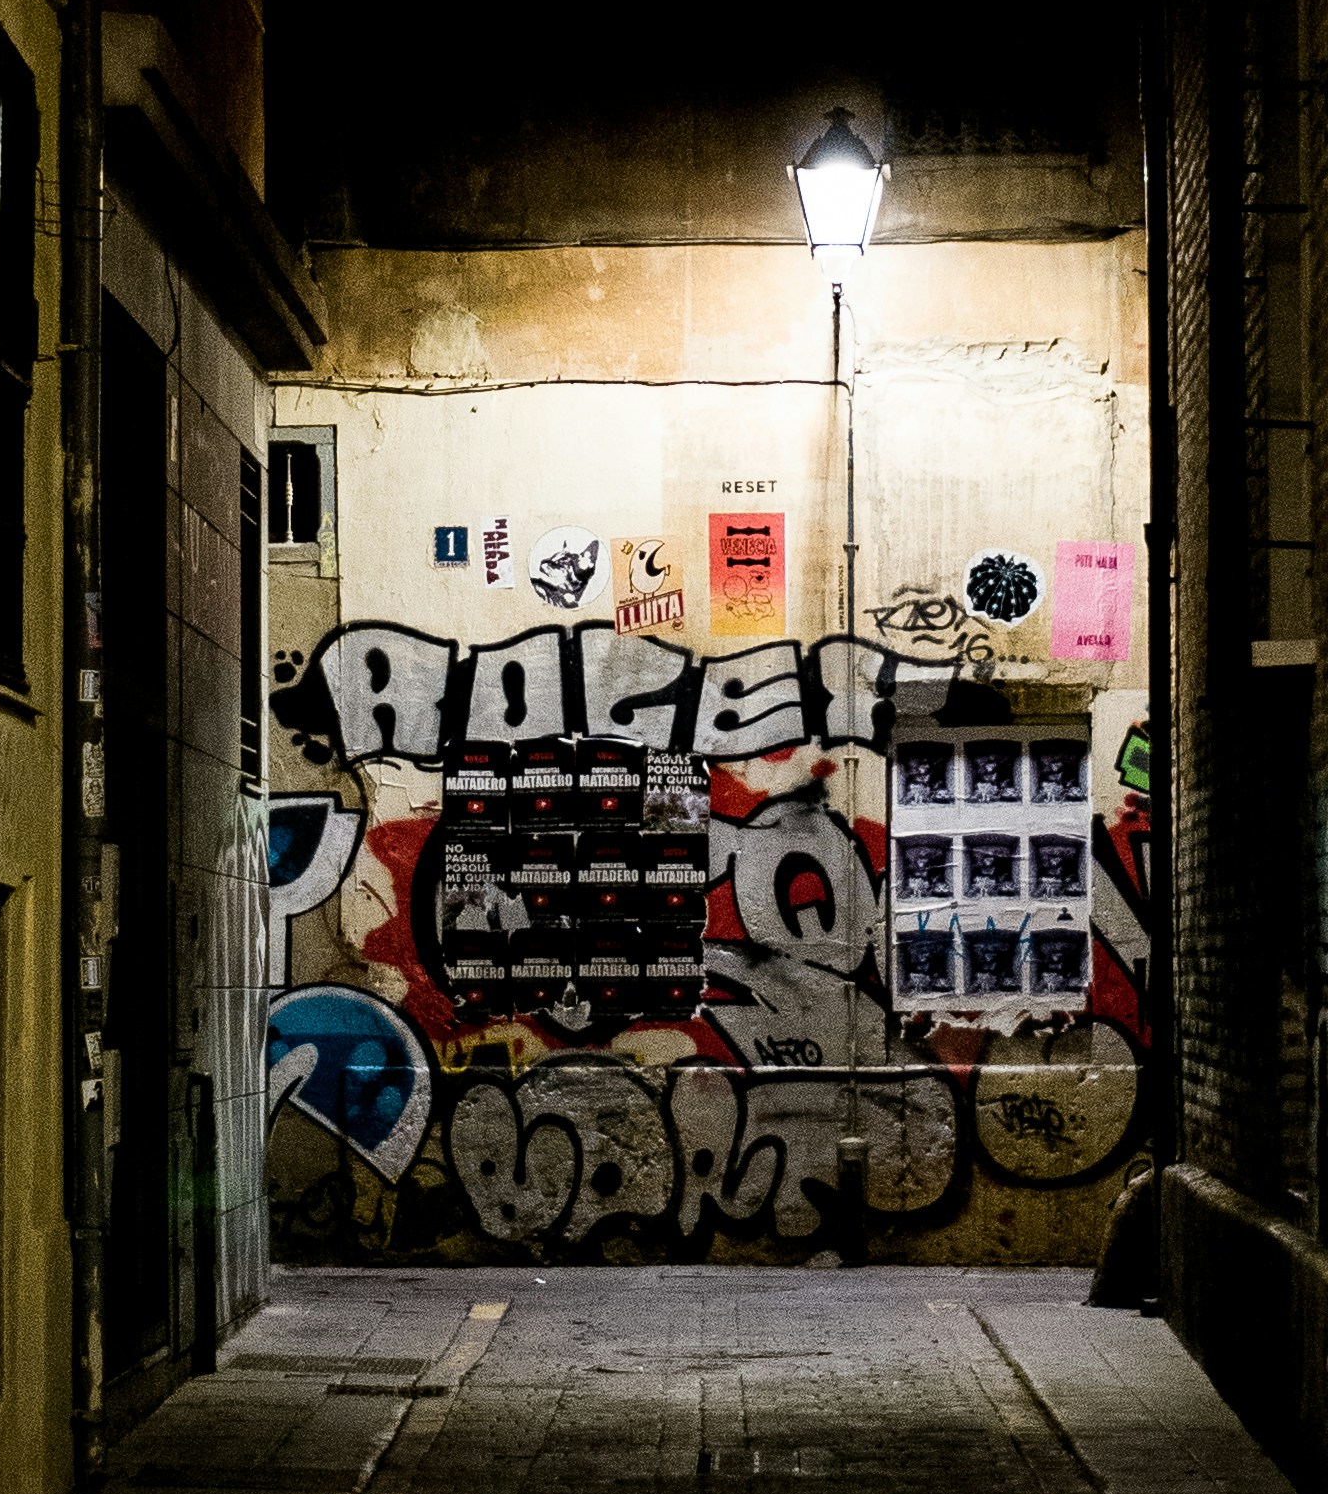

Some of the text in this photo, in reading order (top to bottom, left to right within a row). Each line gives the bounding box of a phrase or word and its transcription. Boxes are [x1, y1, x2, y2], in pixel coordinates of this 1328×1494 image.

[722, 480, 777, 493] RESET
[446, 531, 456, 557] 1
[618, 593, 682, 634] LLUITA
[647, 766, 693, 775] PORQUE
[446, 777, 507, 791] MATADERO
[512, 774, 573, 788] MATADERO
[579, 774, 641, 787] MATADERO
[647, 775, 662, 784] ME
[647, 785, 660, 794] LA
[664, 785, 691, 794] VIDA
[445, 844, 463, 853] NO
[445, 854, 488, 862] PAGUES
[445, 864, 491, 872] PORQUE
[445, 873, 505, 882] ME QUITEN
[511, 871, 571, 884] MATADERO
[578, 869, 639, 883] MATADERO
[645, 870, 706, 884] MATADERO
[445, 883, 459, 892] LA
[511, 965, 572, 978] MATADERO
[579, 964, 640, 977] MATADERO
